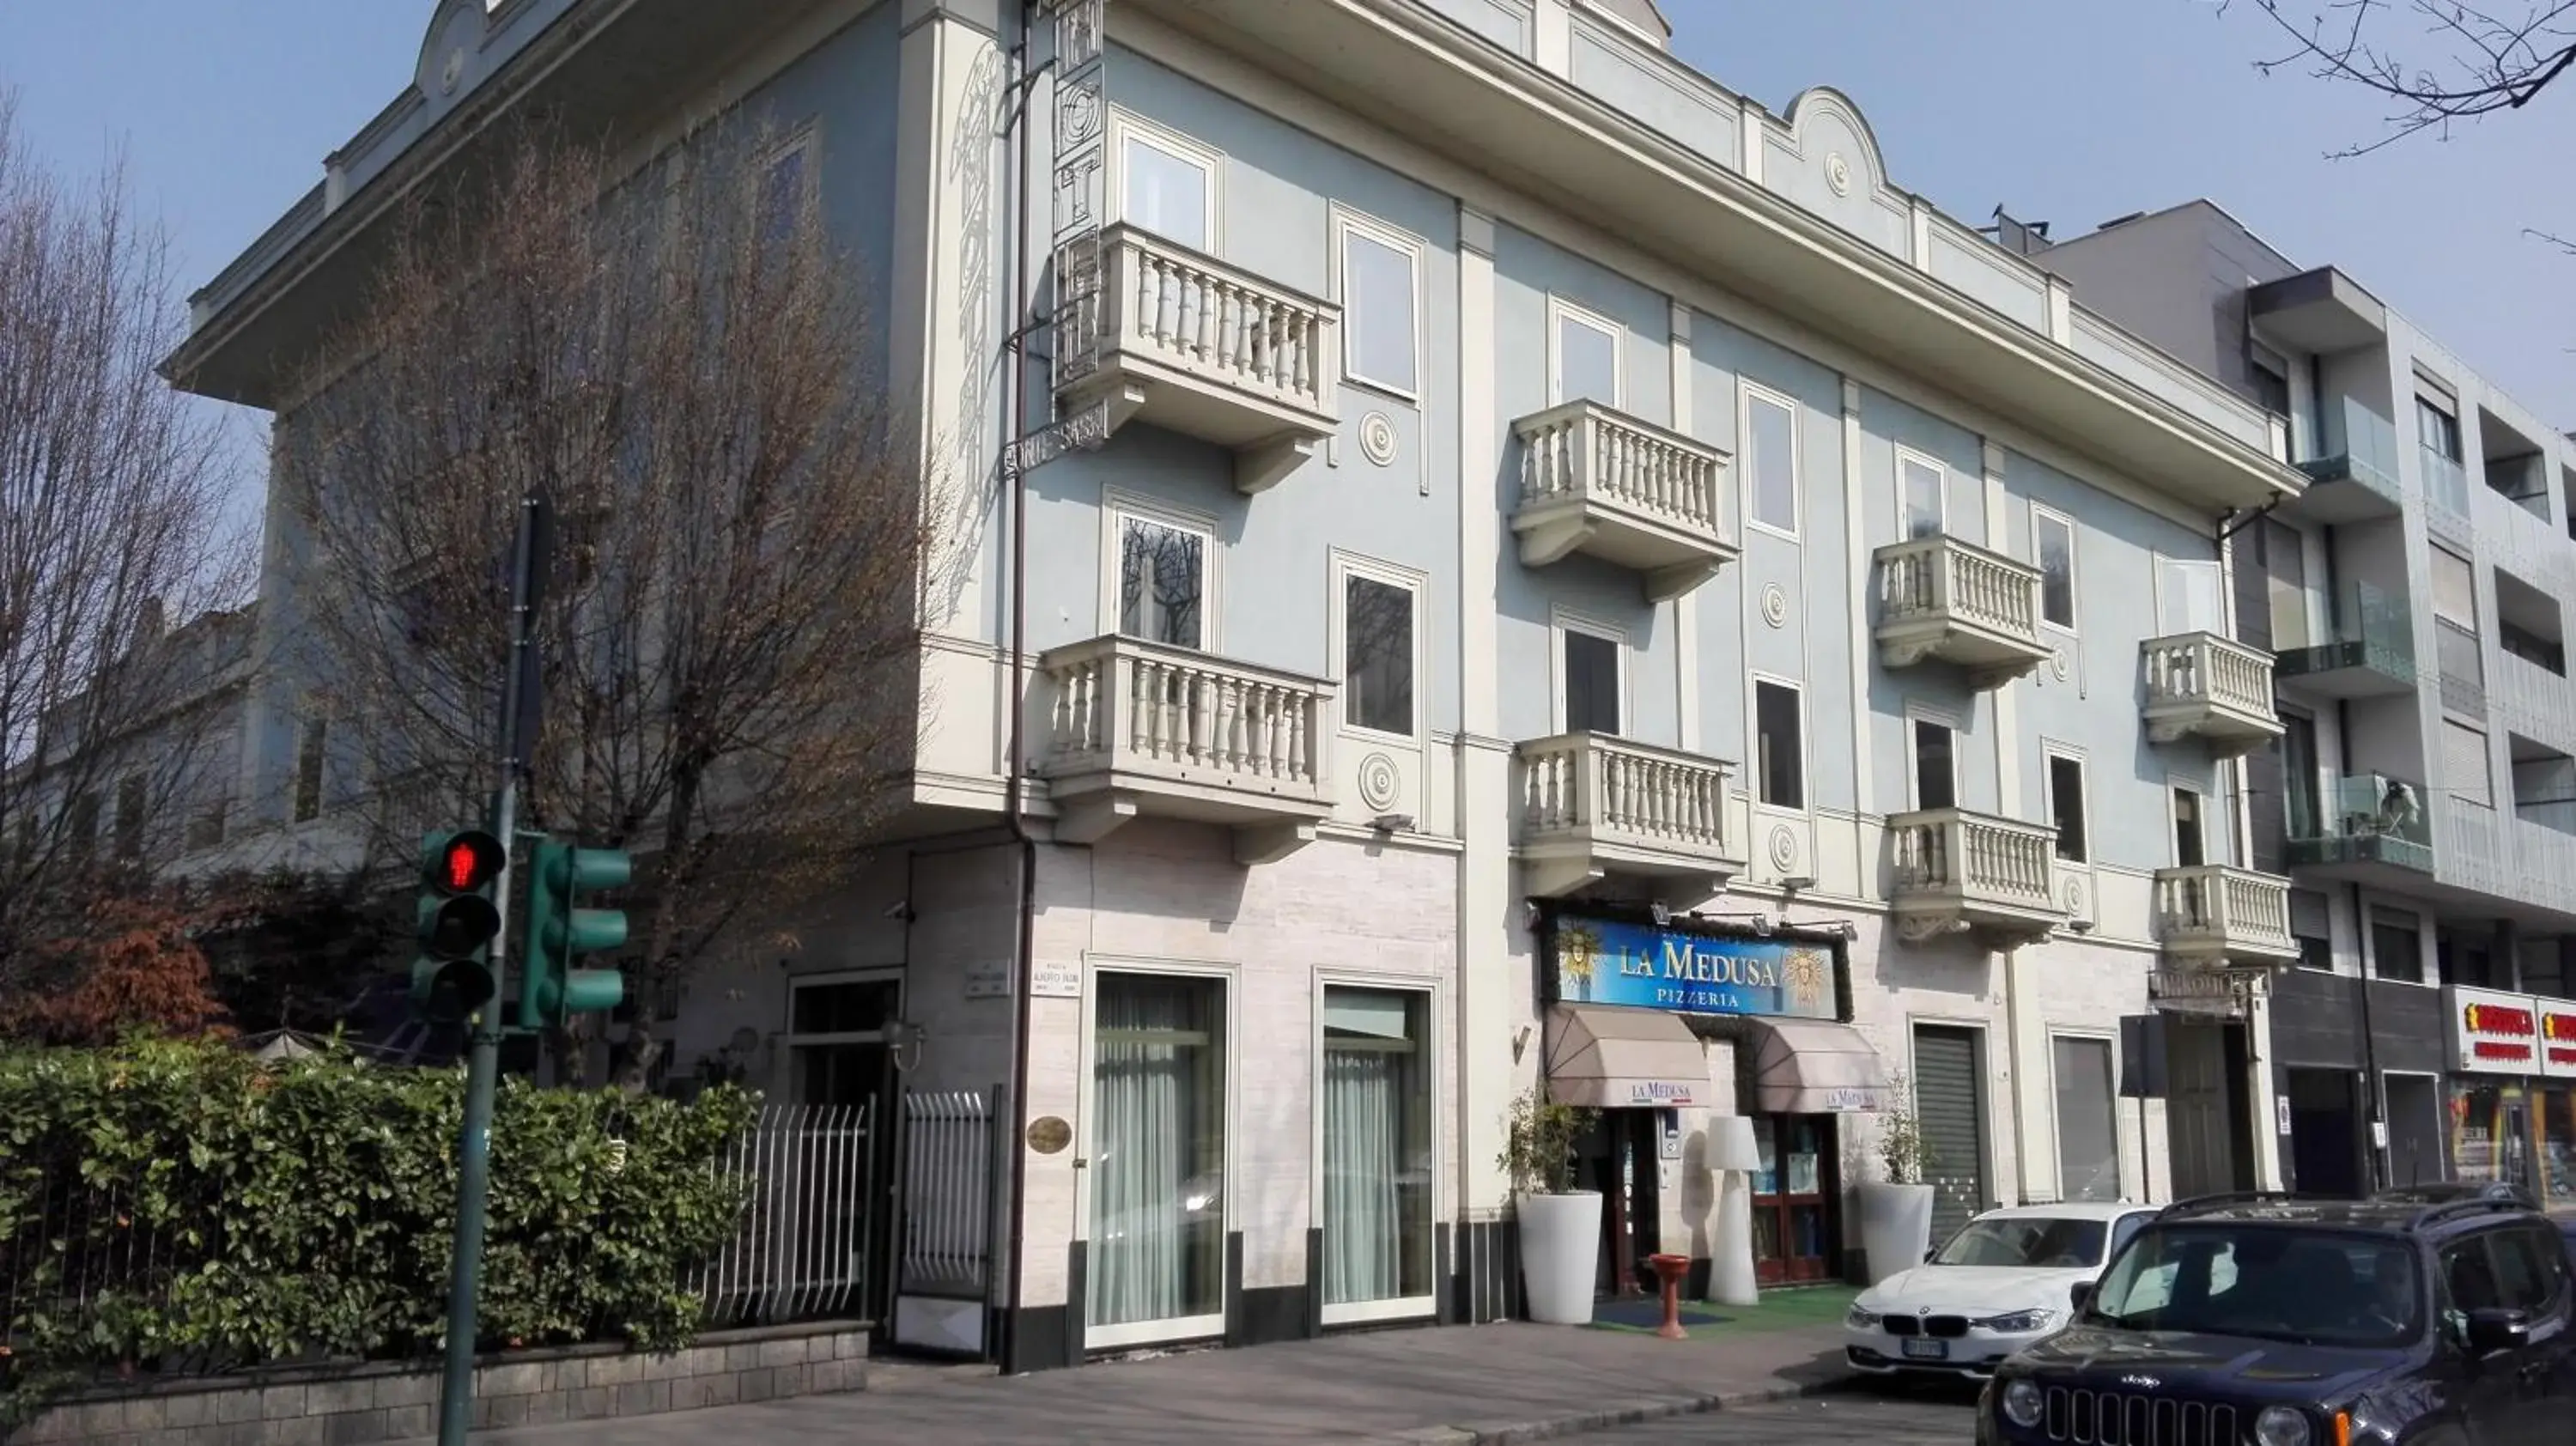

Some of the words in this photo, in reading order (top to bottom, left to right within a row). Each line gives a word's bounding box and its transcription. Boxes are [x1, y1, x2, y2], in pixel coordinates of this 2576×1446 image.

[1620, 945, 1655, 977] LA
[1663, 940, 1777, 987] MEDUSA
[1657, 988, 1739, 1007] PIZZERIA
[1632, 1084, 1645, 1097] LA
